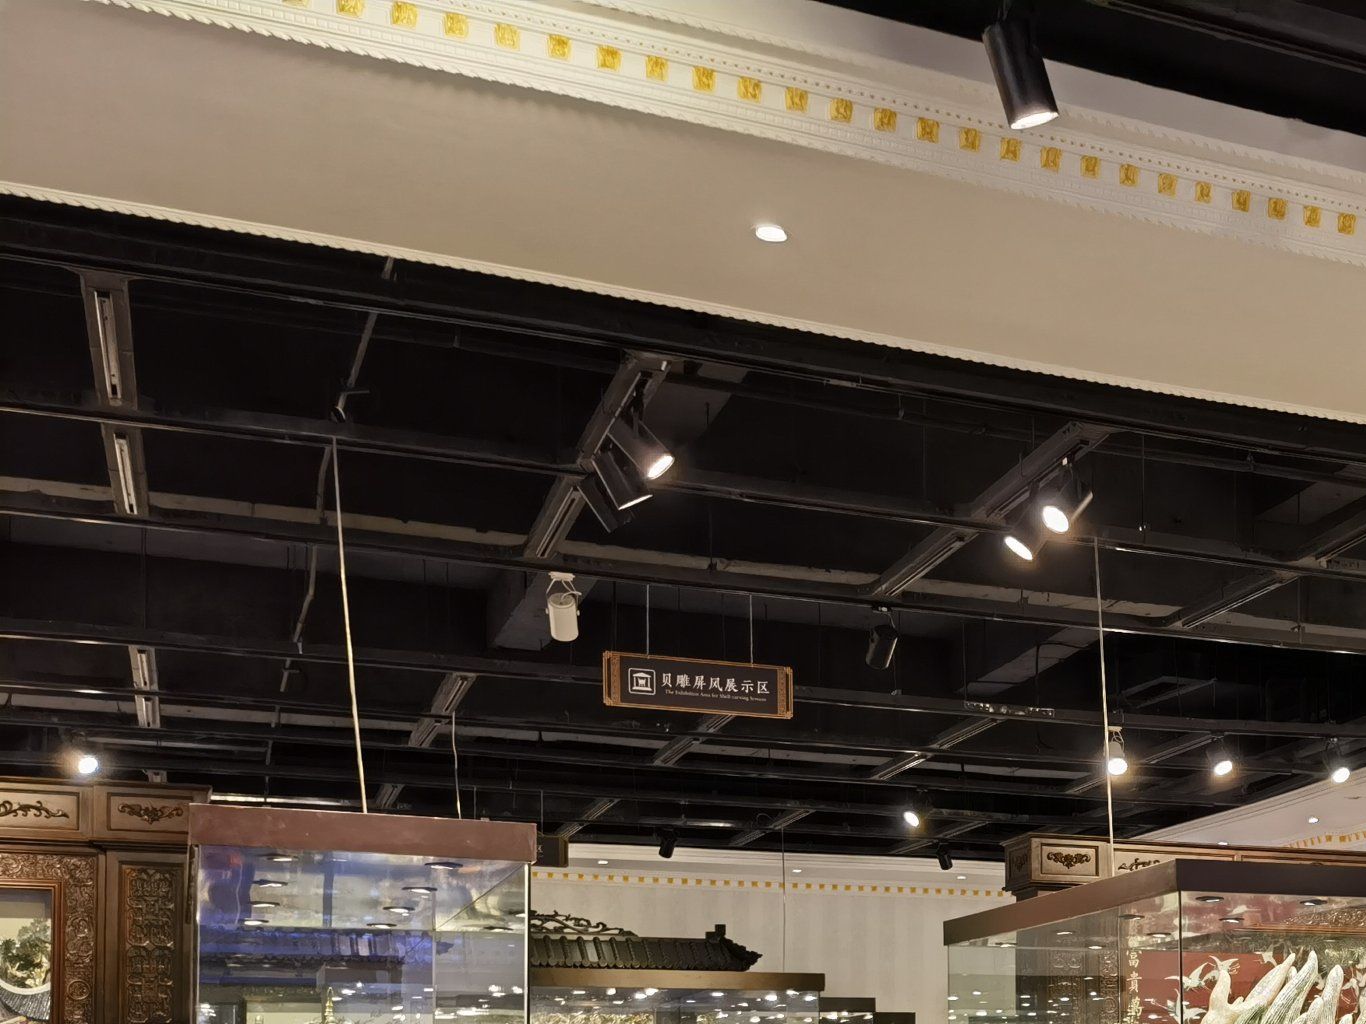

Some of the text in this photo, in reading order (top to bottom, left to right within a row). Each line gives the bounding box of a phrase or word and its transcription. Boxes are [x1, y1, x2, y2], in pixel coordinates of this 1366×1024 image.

[661, 673, 770, 694] 贝雕屏风展示区
